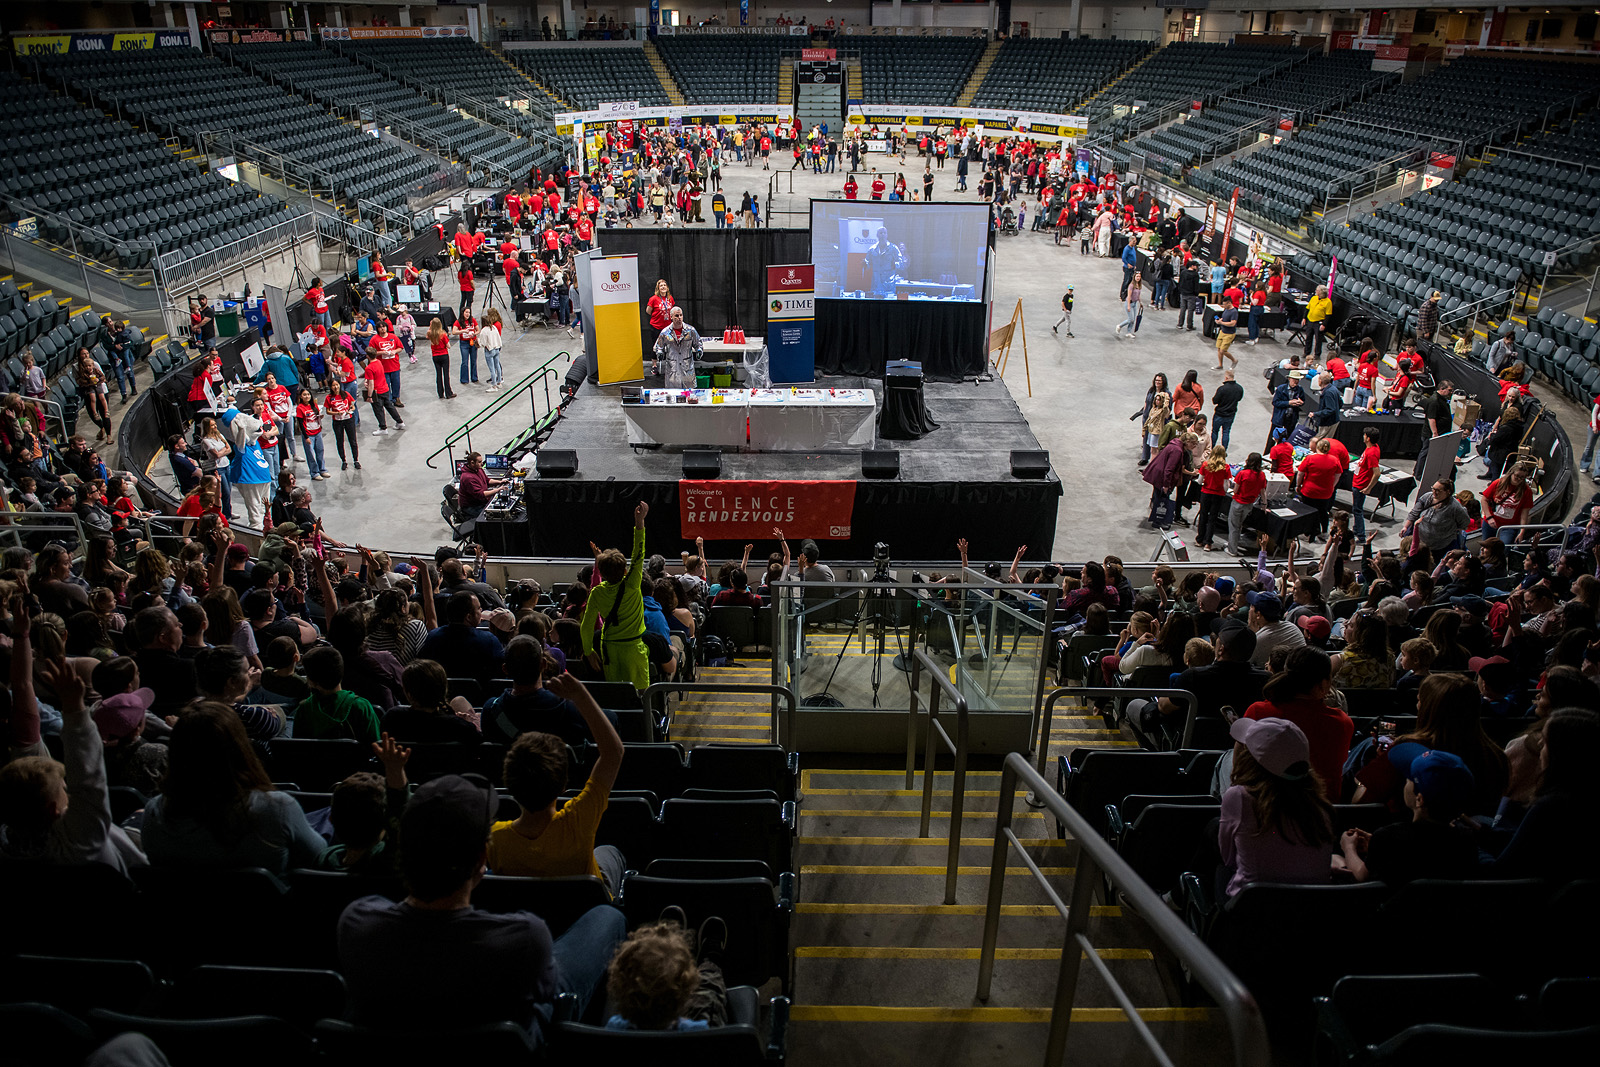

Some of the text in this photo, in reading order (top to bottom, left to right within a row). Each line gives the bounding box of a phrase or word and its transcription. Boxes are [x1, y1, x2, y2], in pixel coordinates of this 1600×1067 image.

[679, 26, 786, 35] LOYALIST COUNTRY CLUB
[76, 38, 106, 51] RONA
[159, 35, 183, 47] RONA
[869, 116, 902, 124] BROCKVILLE
[984, 121, 1007, 129] NAPANEE
[1031, 124, 1057, 134] BELLEVILLE
[784, 299, 813, 309] TIME
[252, 449, 270, 469] S
[686, 488, 715, 496] Welcome
[687, 496, 795, 510] SCIENCE
[687, 511, 795, 523] RENDEZVOUS
